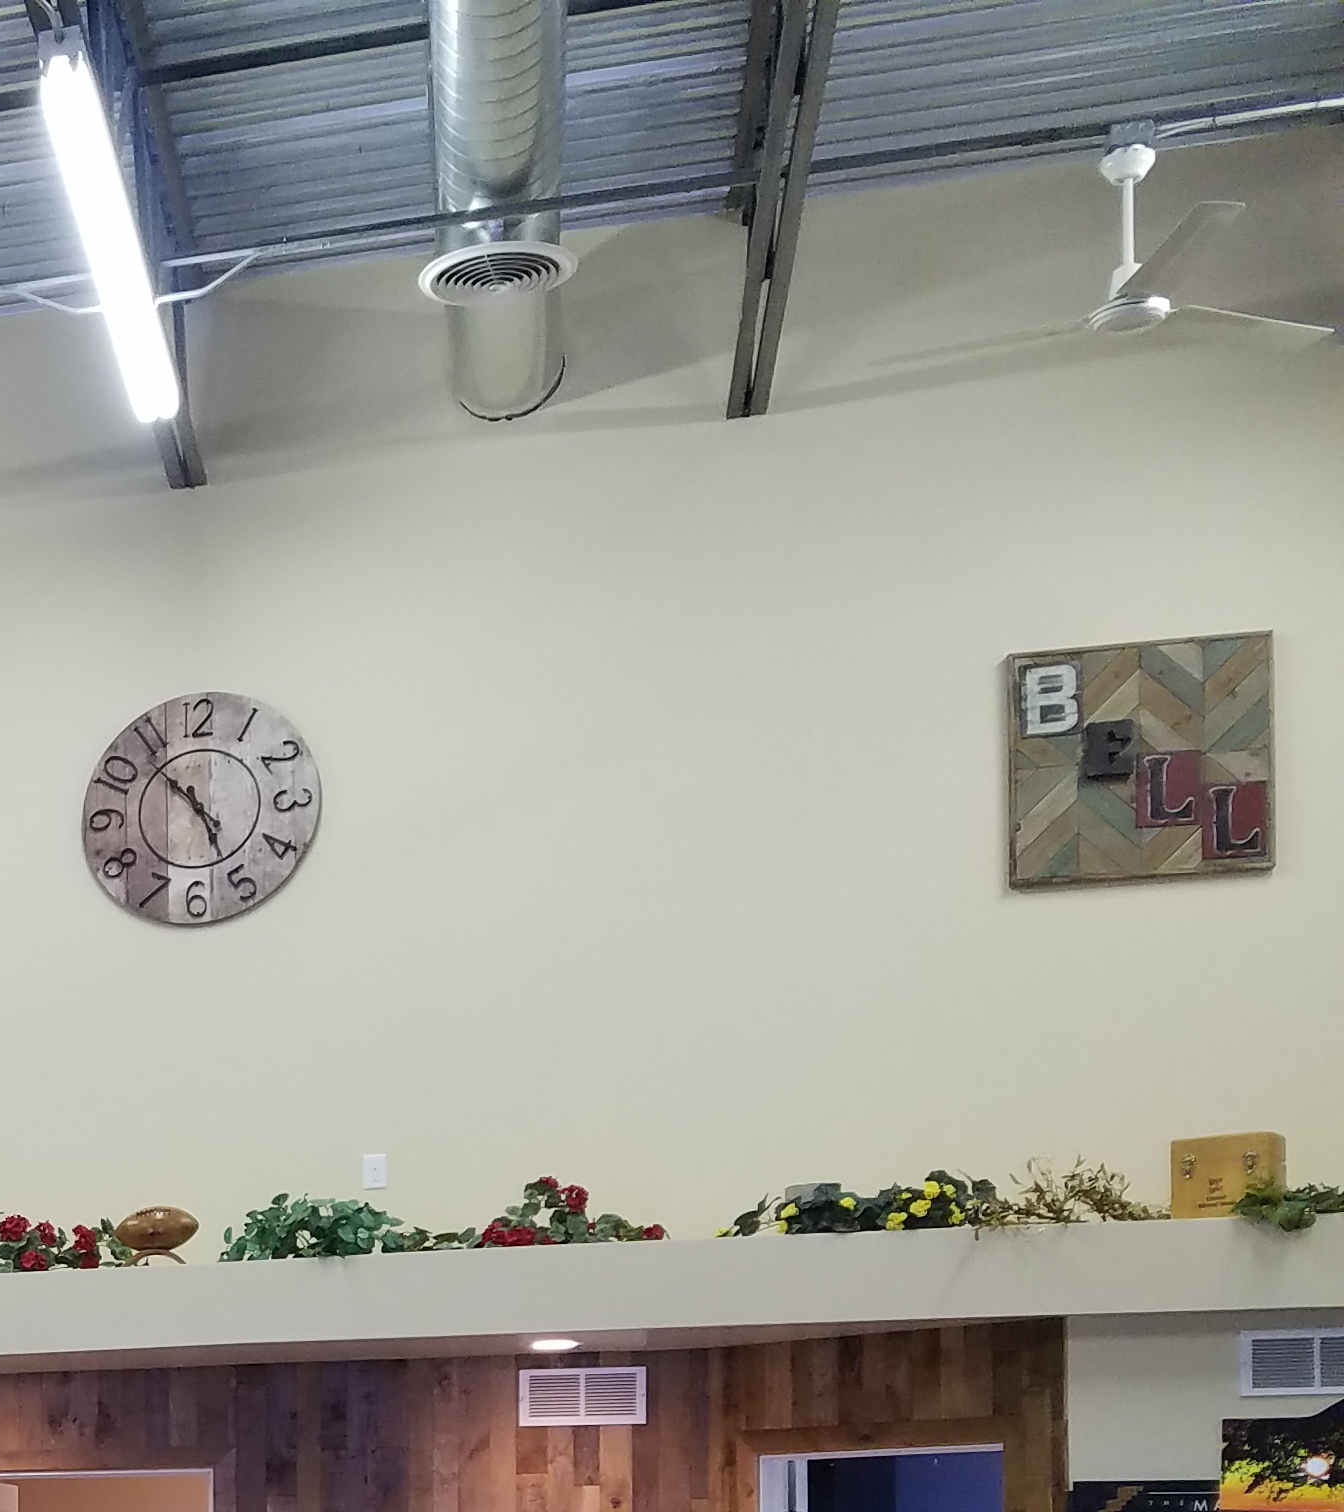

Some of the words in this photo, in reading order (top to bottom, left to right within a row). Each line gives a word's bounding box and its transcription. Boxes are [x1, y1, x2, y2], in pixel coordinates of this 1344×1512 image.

[133, 715, 168, 756] 11
[182, 698, 215, 738] 12
[237, 707, 259, 742] 1
[94, 755, 138, 795] 10
[260, 740, 300, 774] 2
[273, 787, 313, 814] 3
[89, 807, 124, 833] 9
[102, 847, 138, 879] 8
[261, 831, 298, 860] 4
[138, 872, 172, 909] 7
[185, 881, 207, 918] 6
[227, 864, 257, 902] 5
